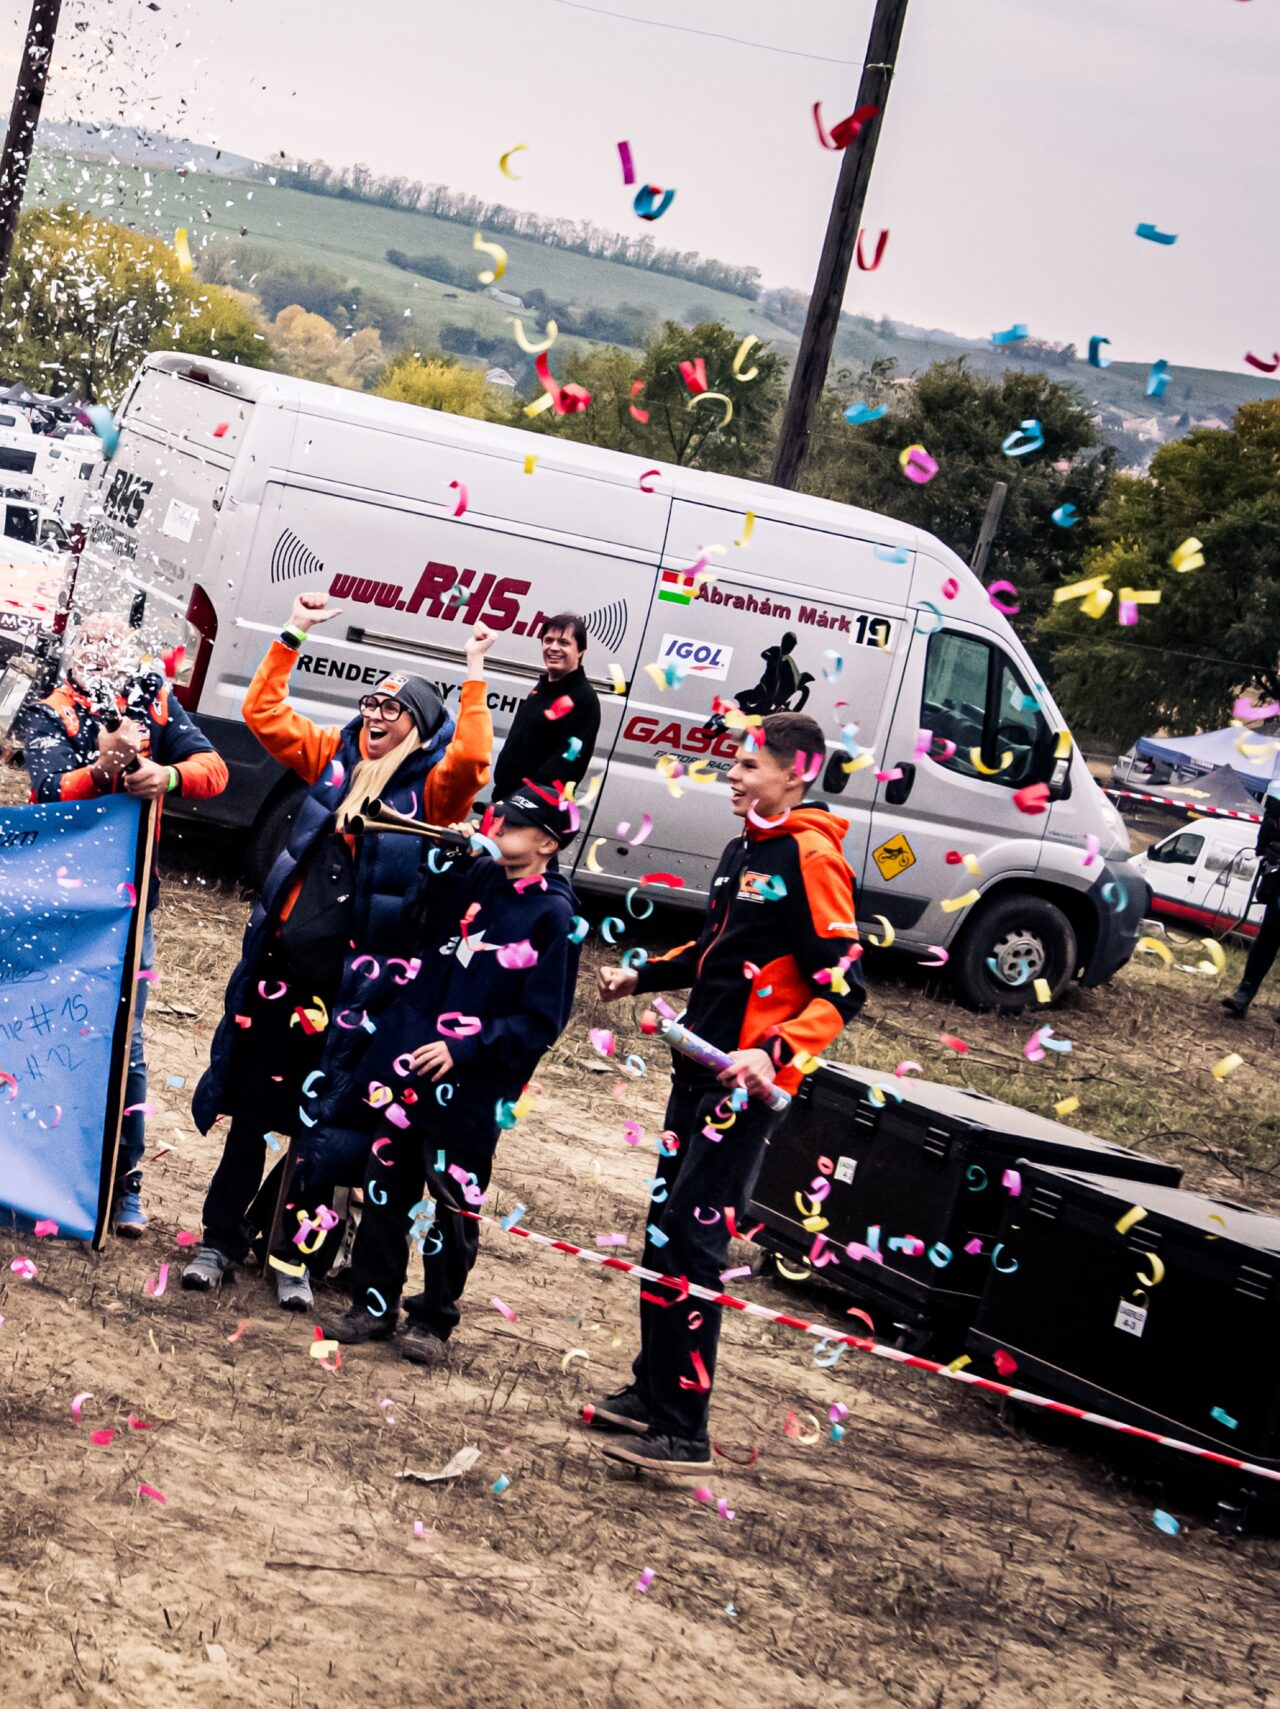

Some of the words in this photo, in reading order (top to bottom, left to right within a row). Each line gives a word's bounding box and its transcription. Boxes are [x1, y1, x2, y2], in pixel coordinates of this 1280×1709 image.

[694, 581, 791, 621] Ábrahám
[797, 605, 852, 634] Márk
[855, 614, 892, 648] 19
[623, 716, 739, 760] GASG
